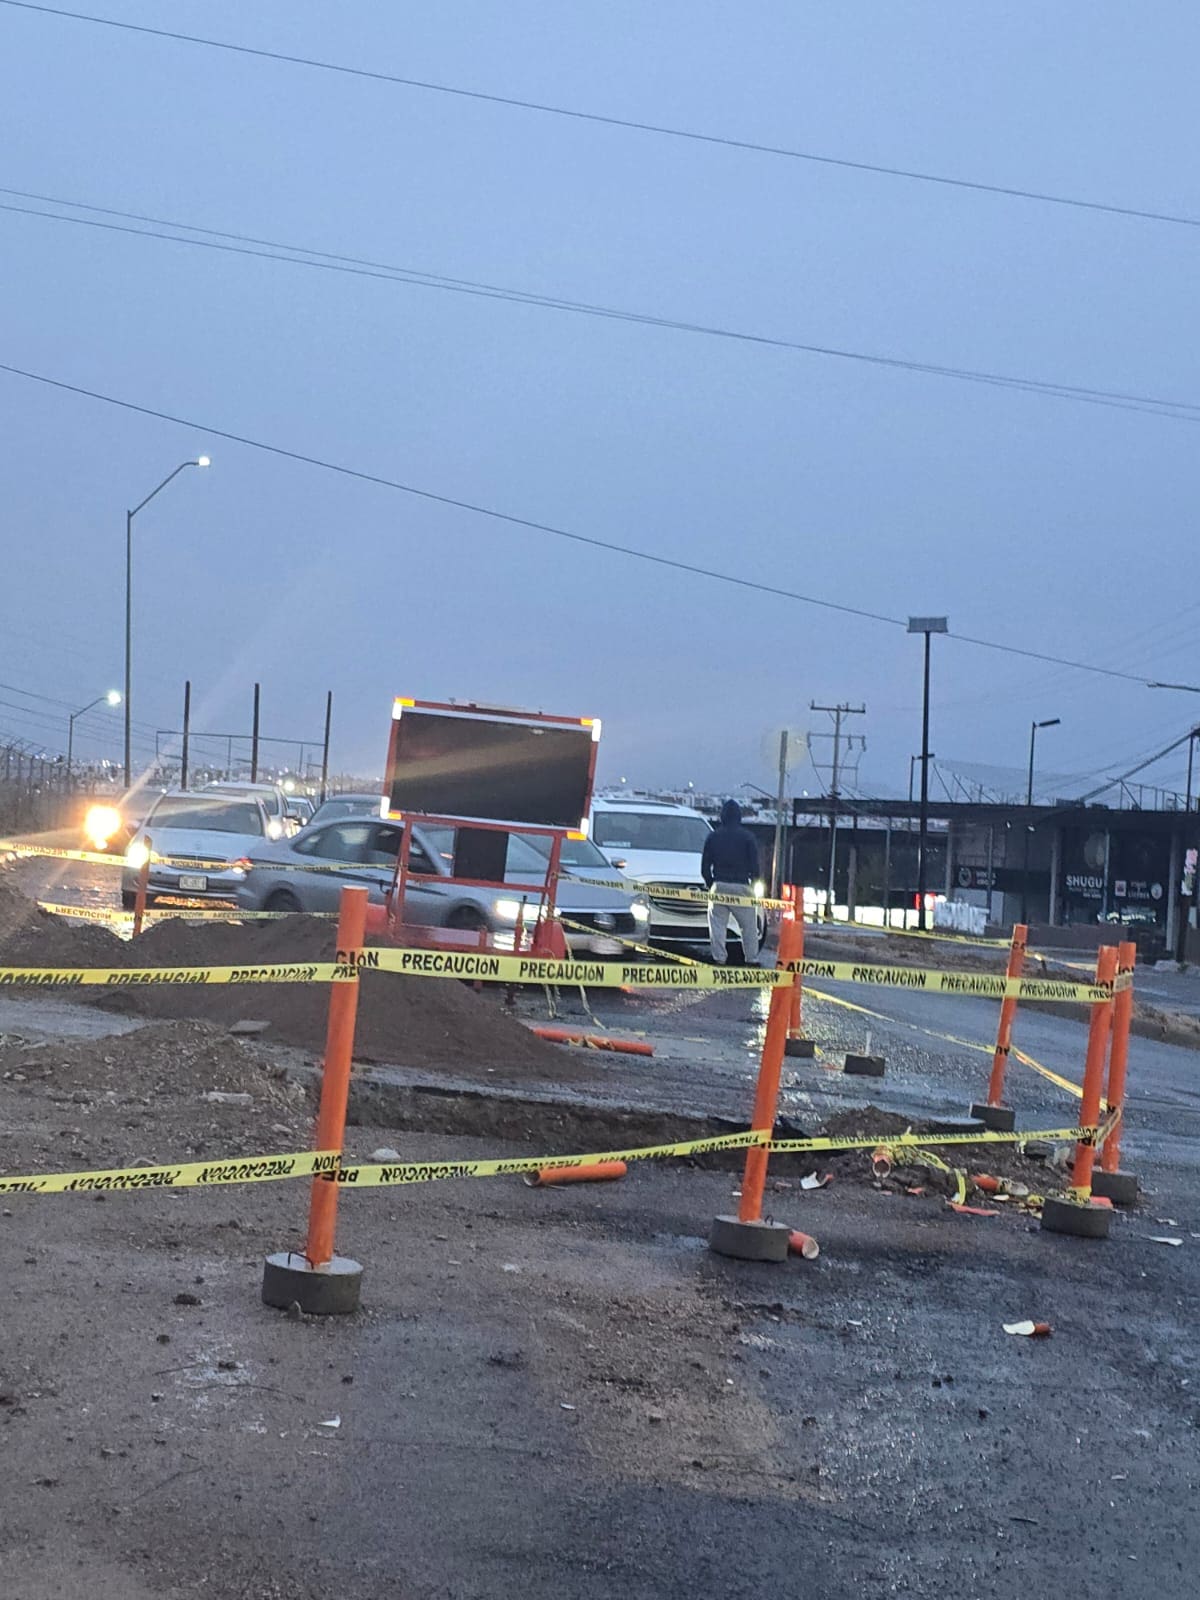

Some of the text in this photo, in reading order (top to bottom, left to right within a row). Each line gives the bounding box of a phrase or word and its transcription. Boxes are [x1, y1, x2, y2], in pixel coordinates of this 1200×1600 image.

[402, 953, 500, 976] PRECAUCIÓN
[519, 961, 605, 982] PRECAUCIÓN
[622, 967, 698, 984] PRECAUCIÓN
